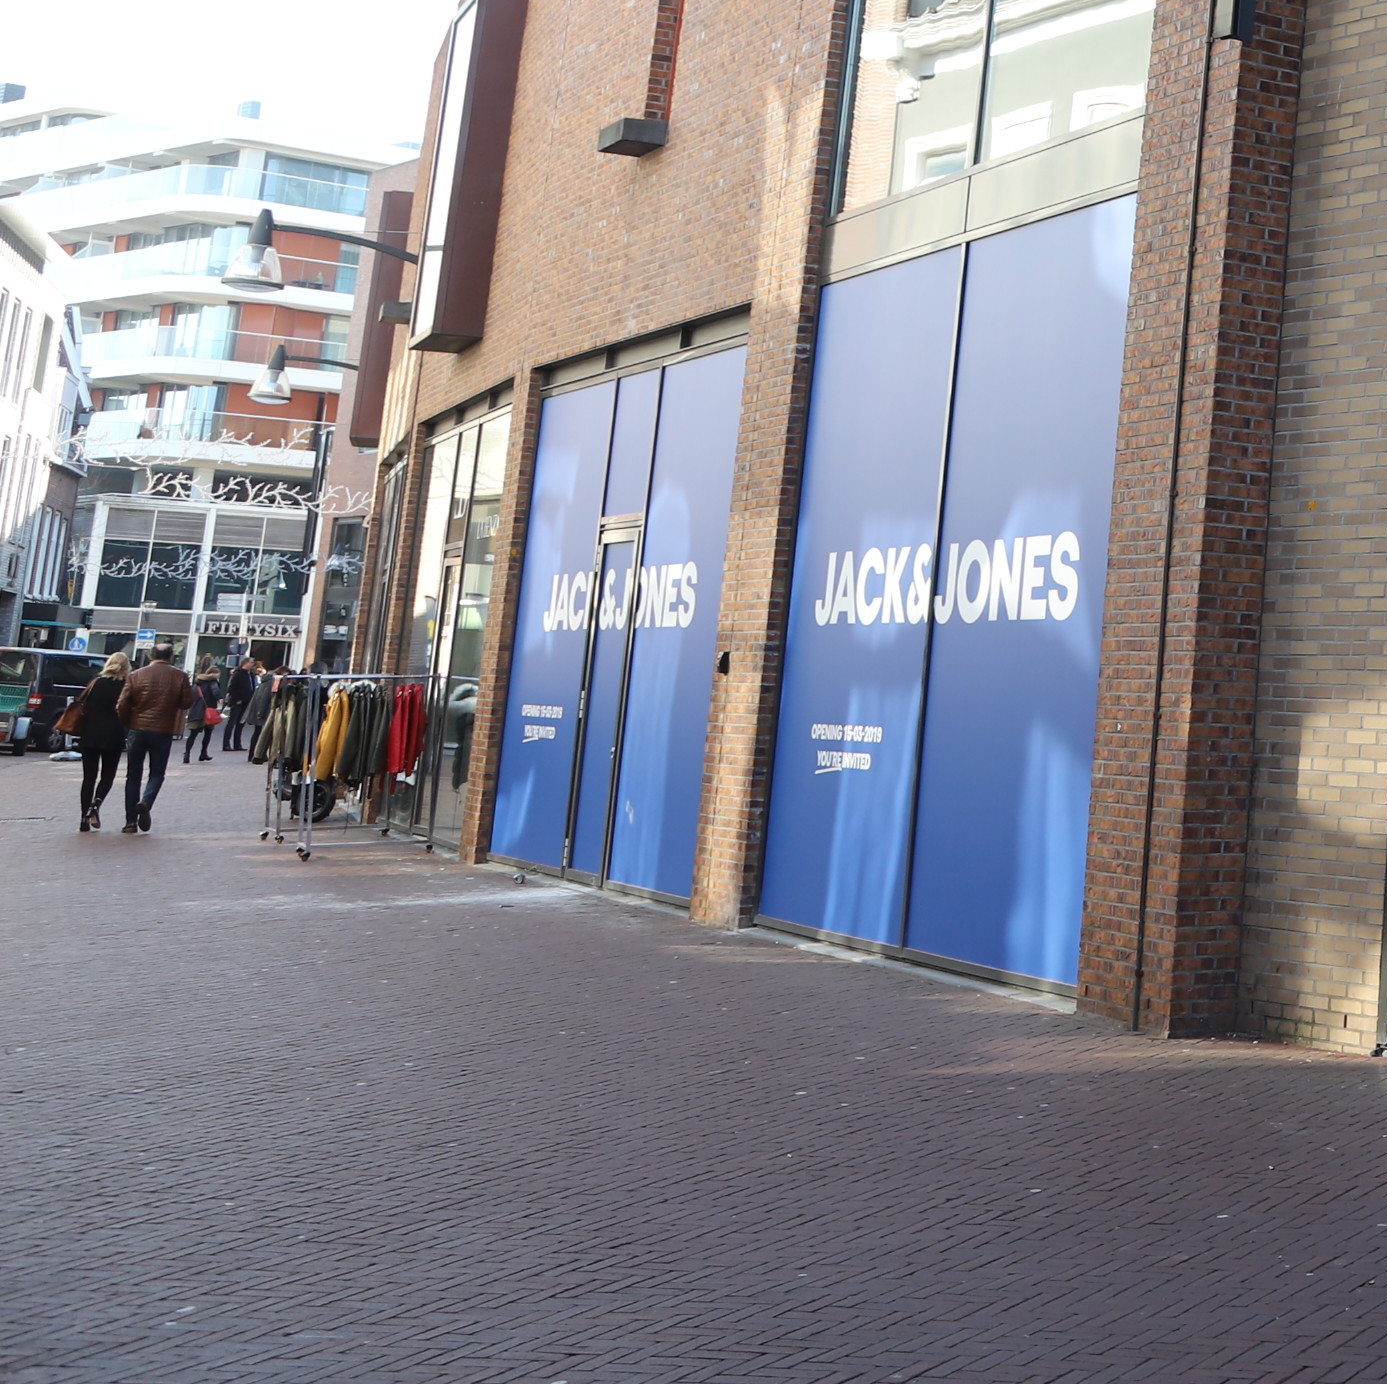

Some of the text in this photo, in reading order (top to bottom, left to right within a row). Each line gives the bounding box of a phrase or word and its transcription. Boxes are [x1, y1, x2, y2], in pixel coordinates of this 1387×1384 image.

[811, 723, 883, 743] OPENING 15-03-2019
[841, 751, 871, 770] INVITED
